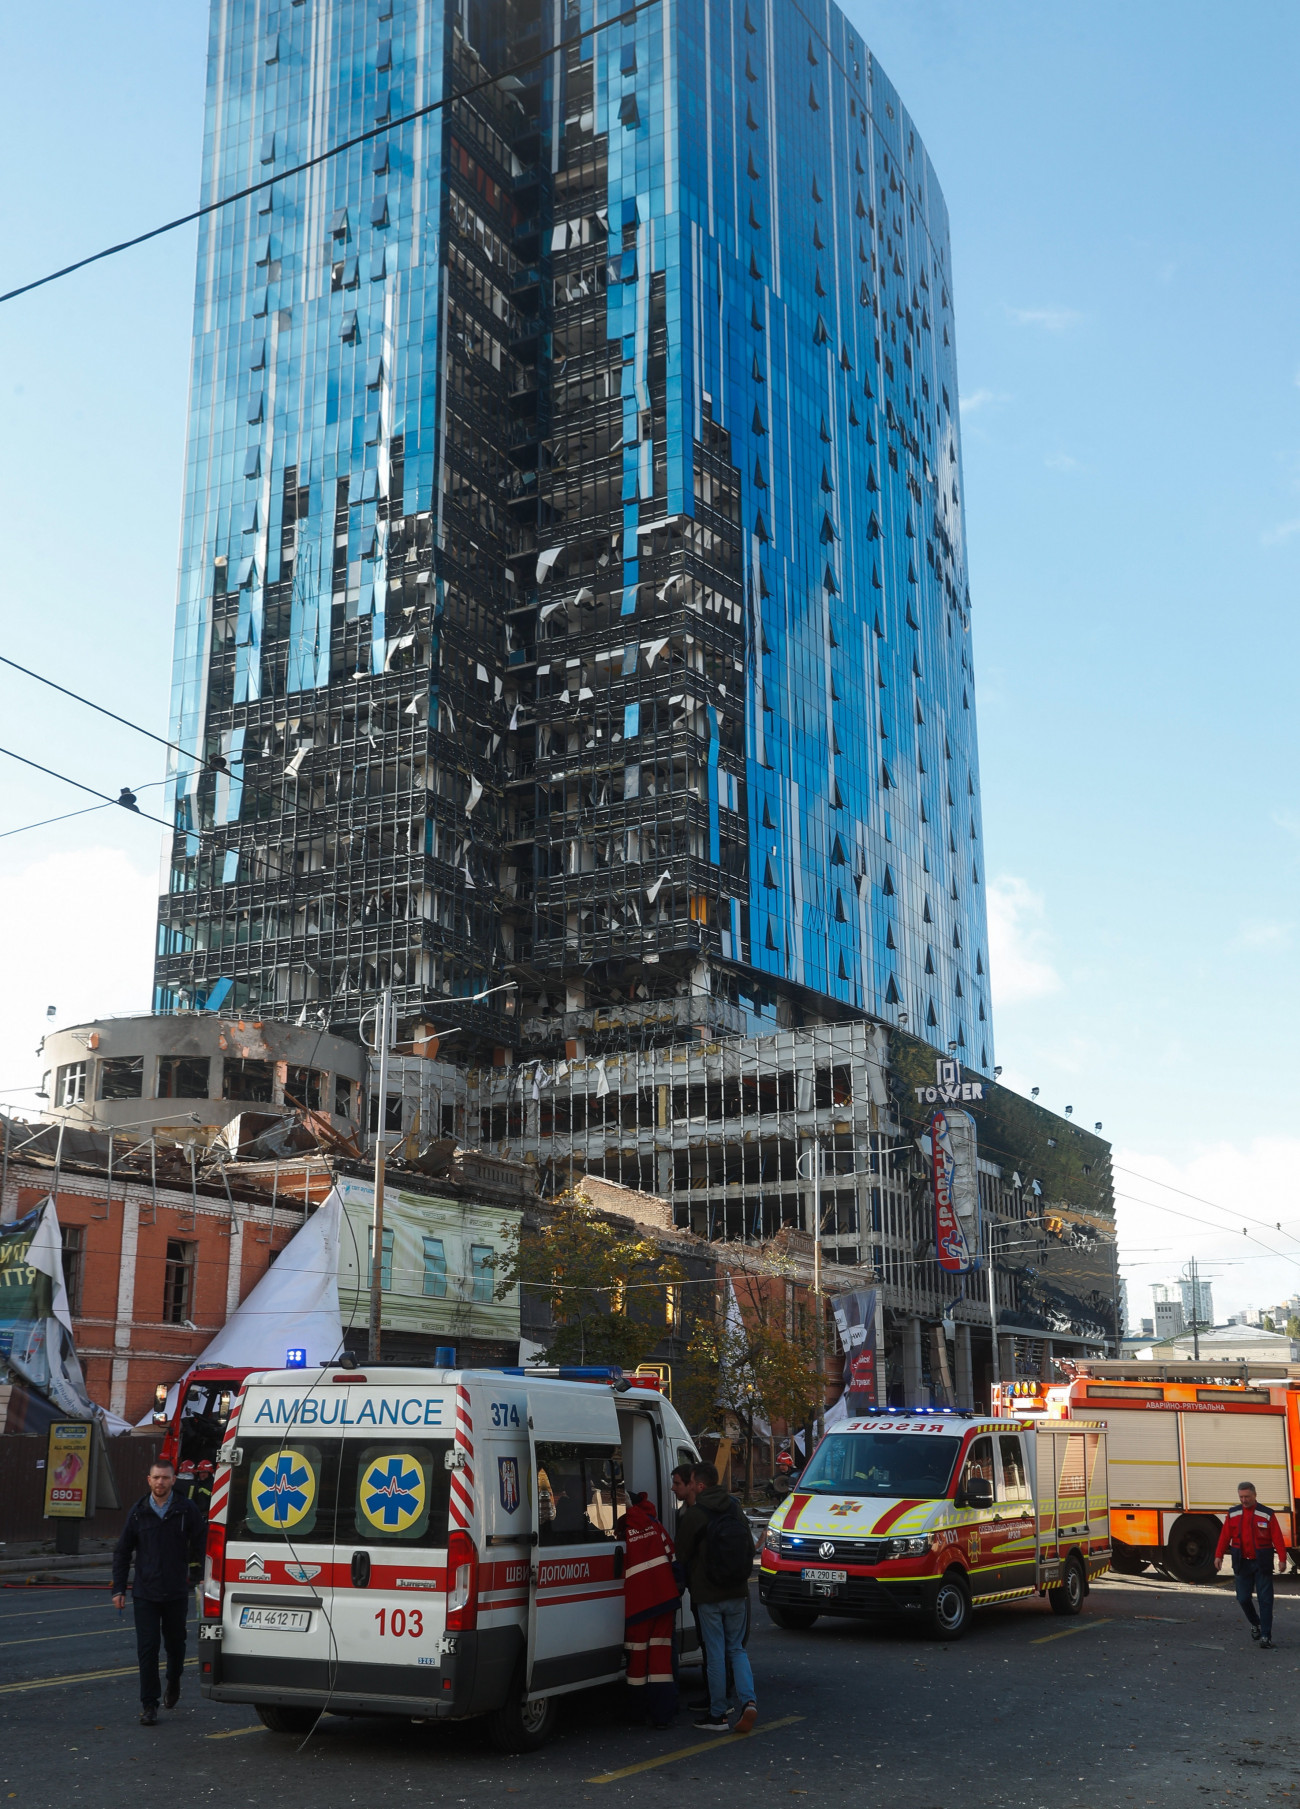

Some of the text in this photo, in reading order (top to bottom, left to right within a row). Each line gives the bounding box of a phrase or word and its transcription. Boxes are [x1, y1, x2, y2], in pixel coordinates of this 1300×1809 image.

[914, 1082, 983, 1104] TOWER
[254, 1398, 444, 1425] AMBULANCE
[490, 1402, 520, 1427] 374
[1145, 1401, 1226, 1411] АВАРІЙНО-РЯТУВАЛЬНА
[52, 1489, 73, 1500] 890
[539, 1562, 590, 1585] ДОПОМОГА
[805, 1570, 837, 1580] KA 290 E
[247, 1610, 262, 1624] AA
[265, 1611, 288, 1626] 4612
[374, 1607, 424, 1638] 103
